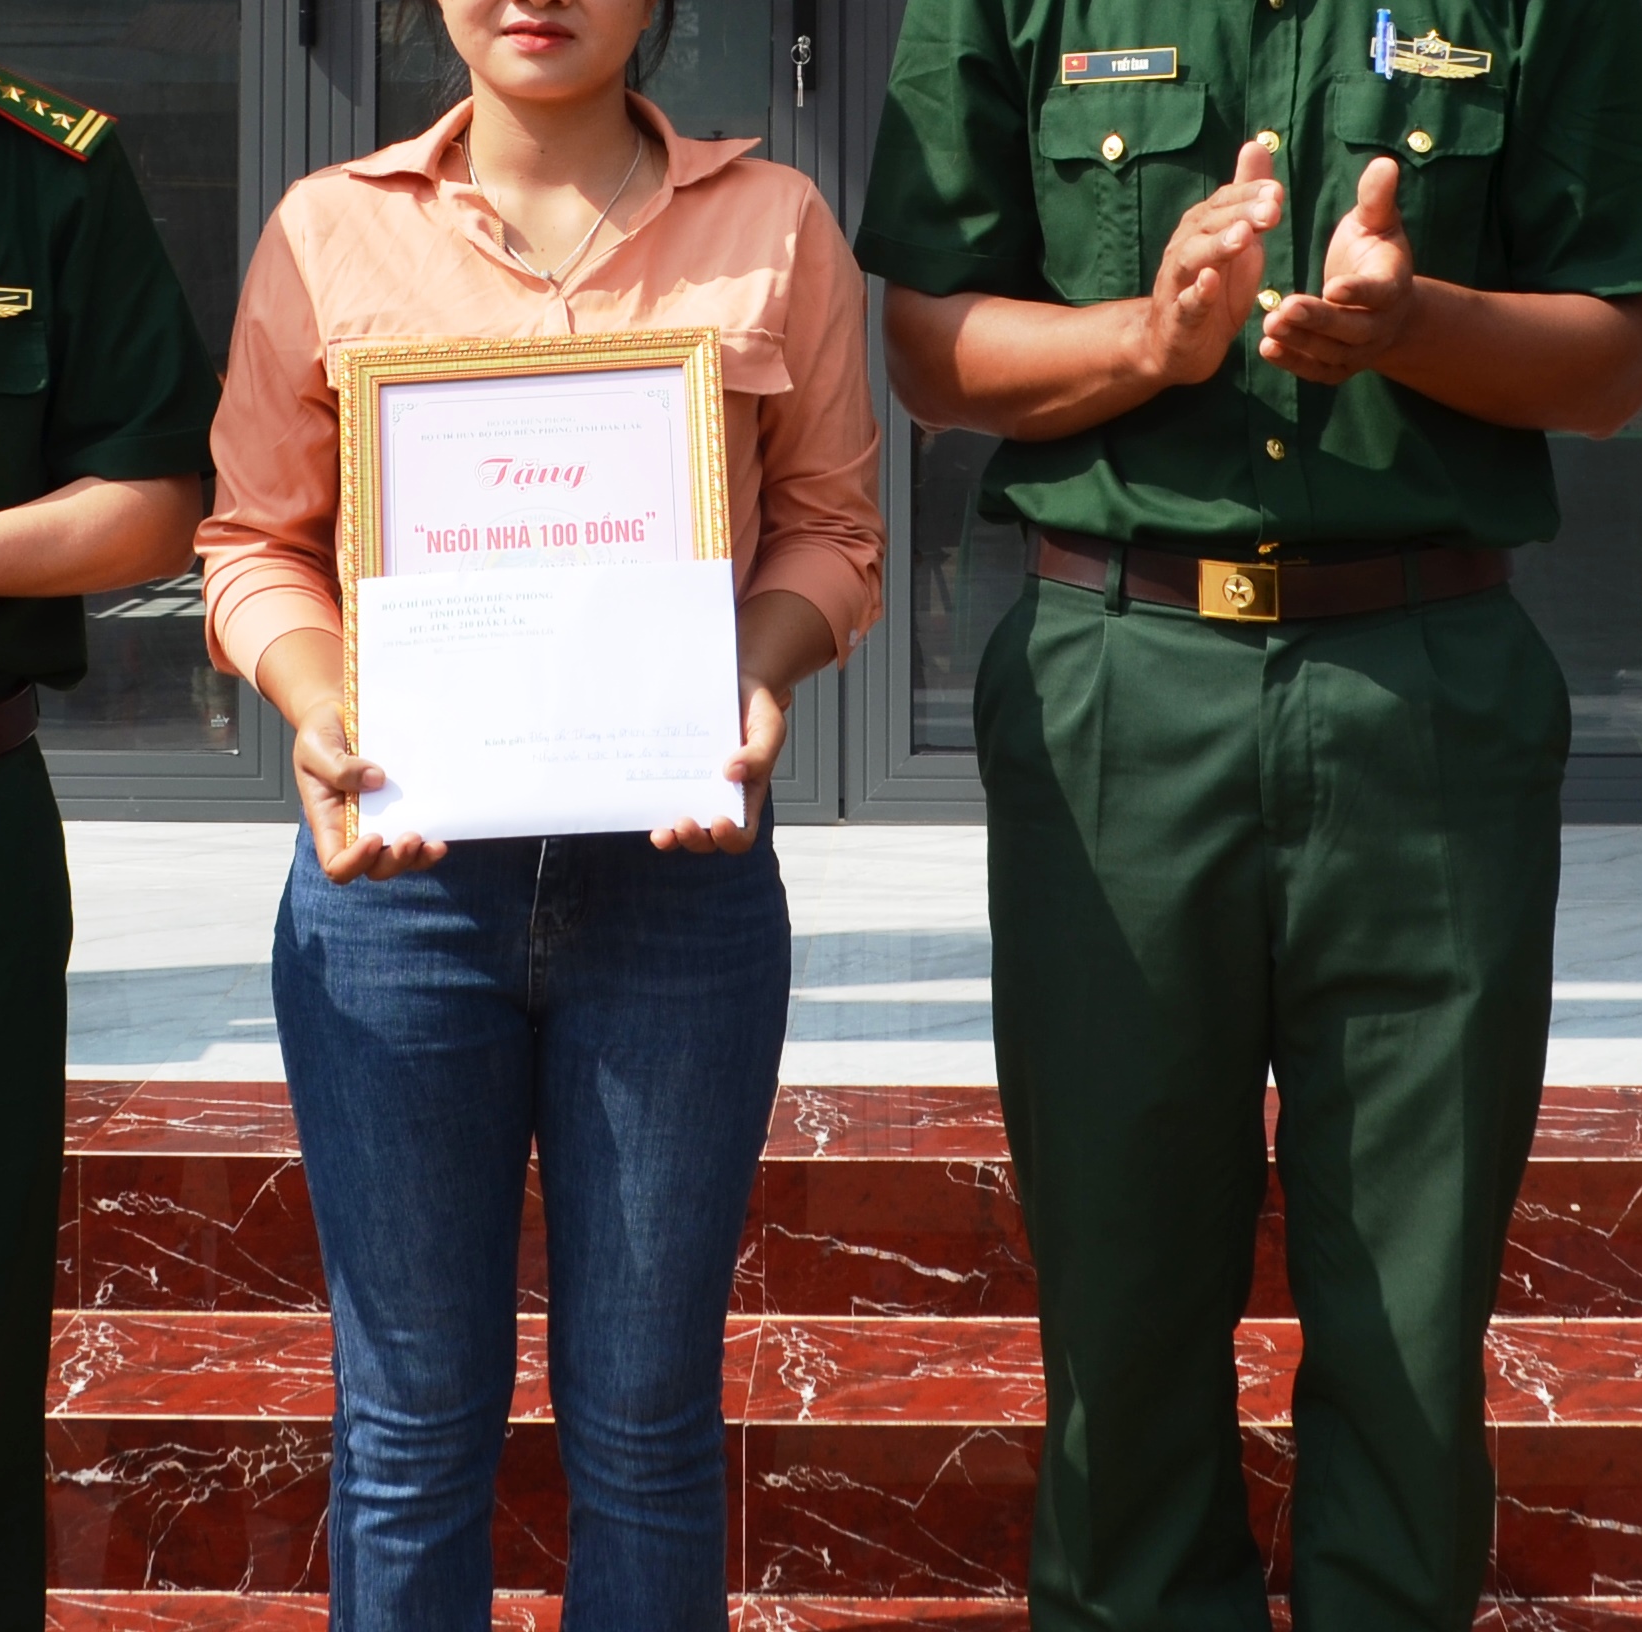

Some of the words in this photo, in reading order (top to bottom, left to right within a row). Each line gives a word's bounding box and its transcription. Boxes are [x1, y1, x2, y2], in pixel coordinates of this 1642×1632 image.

[477, 457, 592, 491] Tặng
[486, 518, 531, 551] NHÀ
[539, 522, 578, 548] 100
[421, 597, 444, 608] HUY
